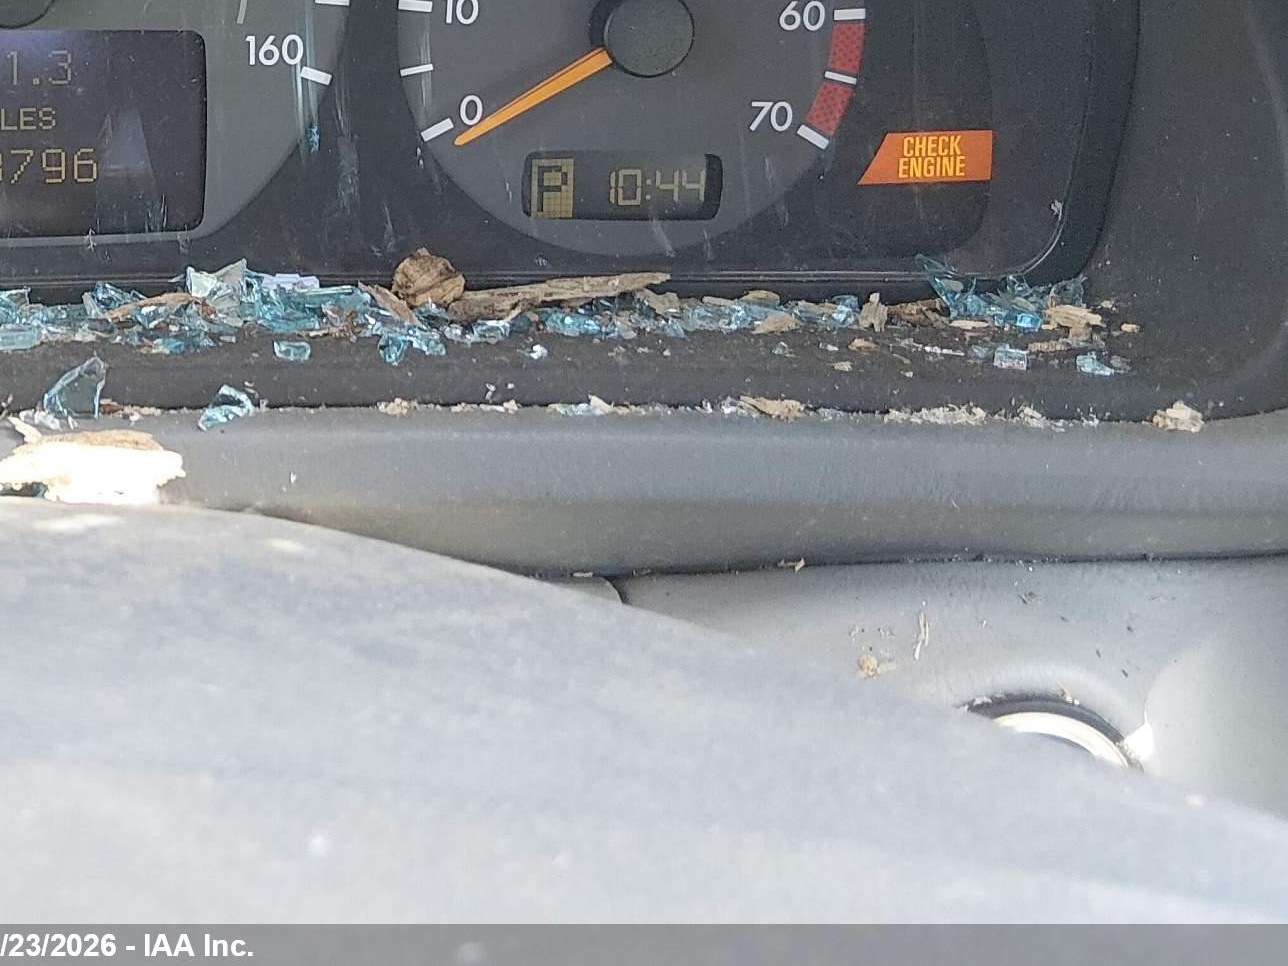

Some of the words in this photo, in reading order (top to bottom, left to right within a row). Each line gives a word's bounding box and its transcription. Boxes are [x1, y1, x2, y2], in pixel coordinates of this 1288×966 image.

[778, 0, 826, 31] 60
[246, 34, 303, 66] 160
[459, 95, 482, 126] 0
[749, 101, 792, 131] 70
[902, 135, 961, 156] CHECK
[898, 156, 965, 178] ENGINE
[538, 166, 568, 212] P
[609, 169, 705, 207] 10:44
